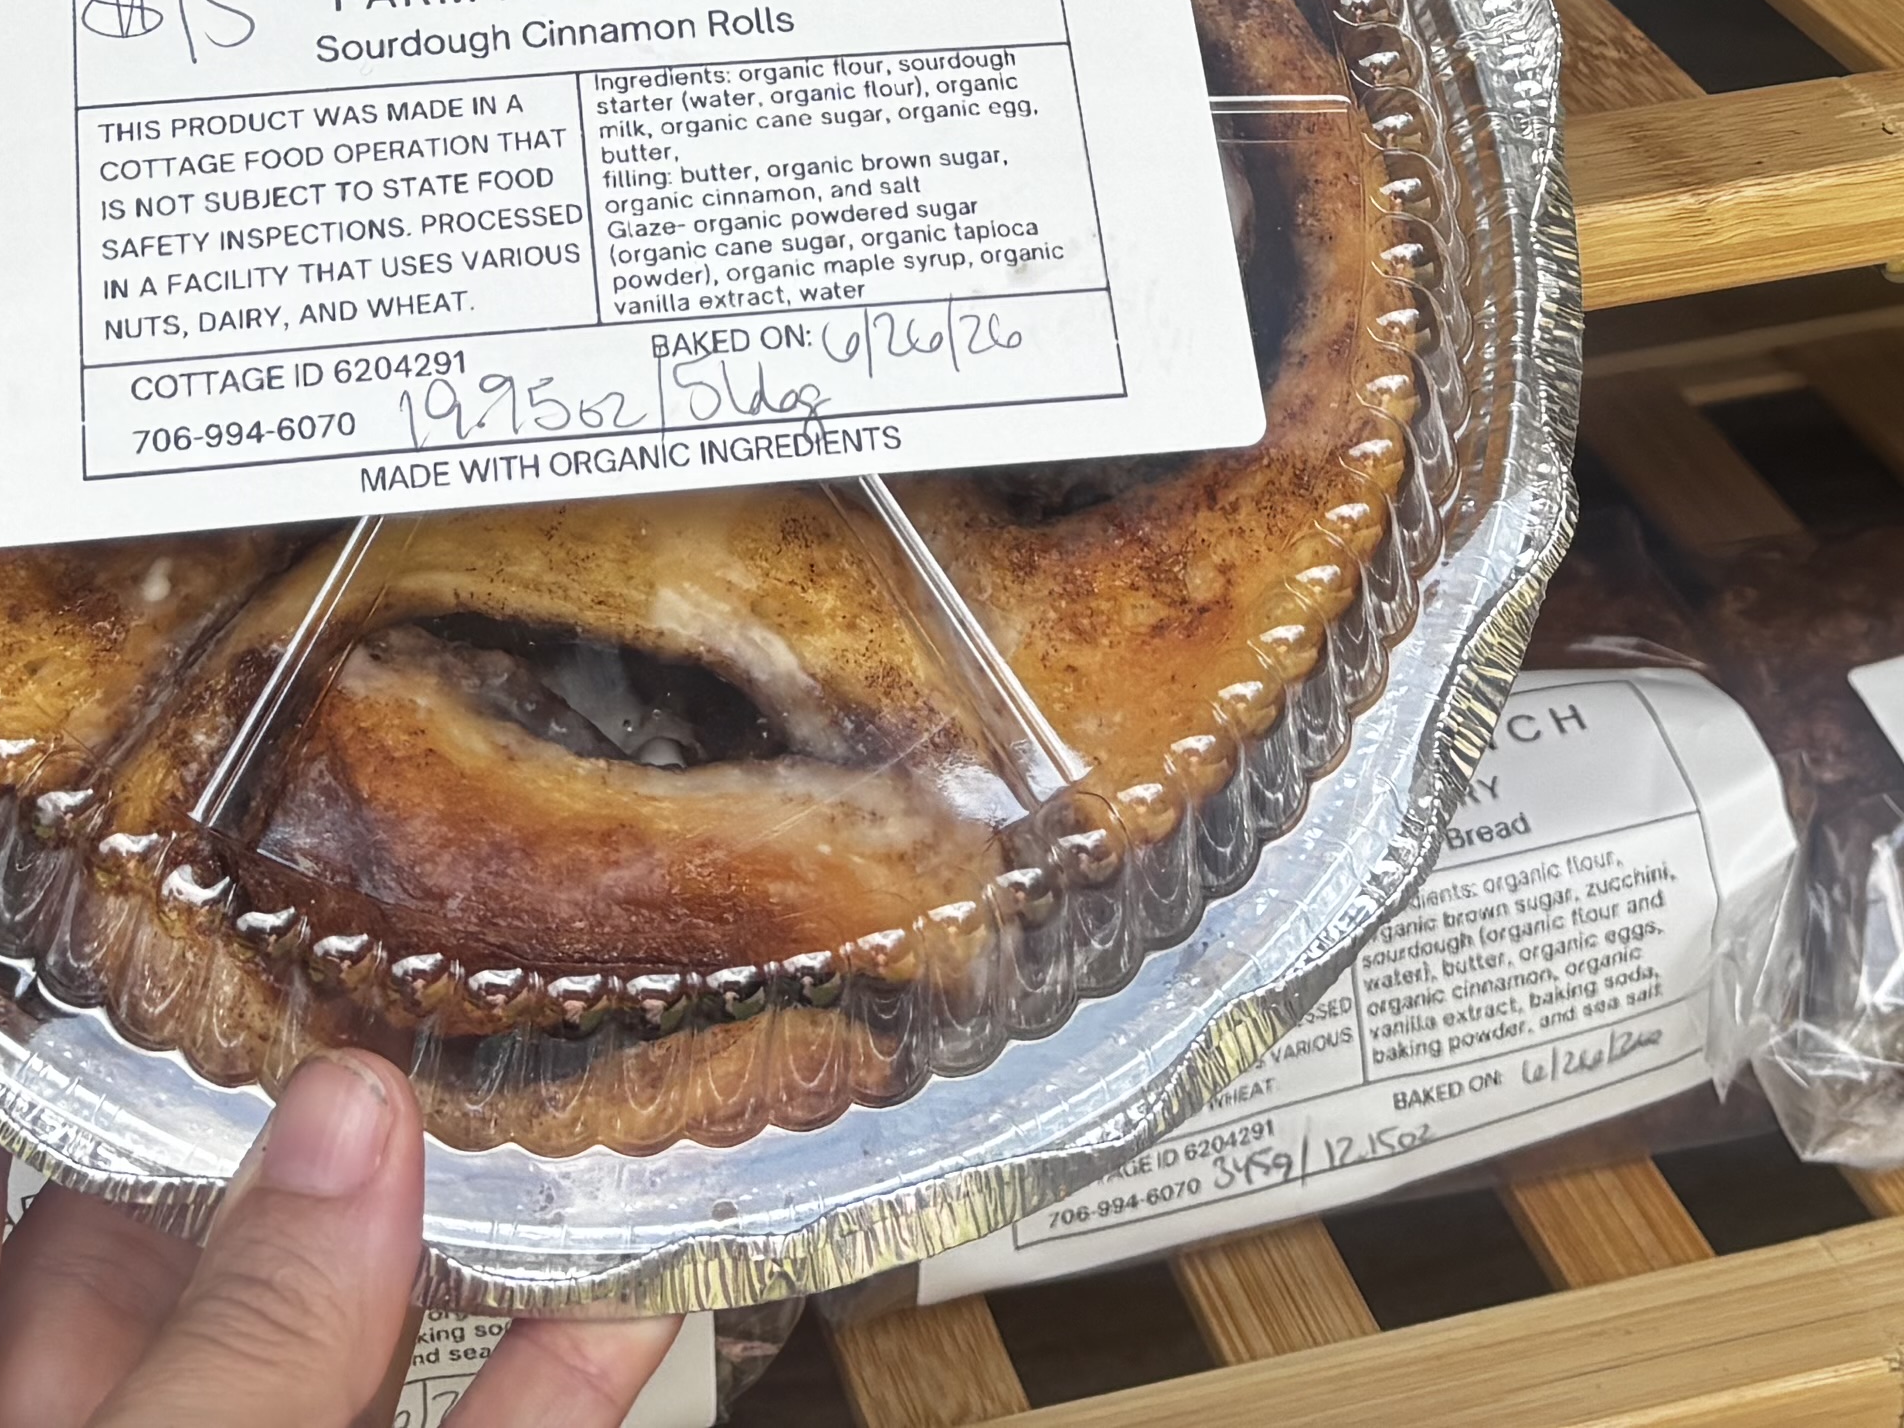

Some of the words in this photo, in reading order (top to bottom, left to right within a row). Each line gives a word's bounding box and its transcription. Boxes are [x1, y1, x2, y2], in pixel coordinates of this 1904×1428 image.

[315, 22, 511, 64] Sourdough
[521, 17, 697, 49] Cinnamon
[707, 5, 796, 38] Rolls
[593, 67, 733, 94] Ingredients:
[738, 61, 826, 87] organic
[831, 56, 894, 78] flour,
[897, 48, 1018, 74] sourdough
[96, 119, 162, 145] THIS
[170, 108, 305, 139] PRODUCT
[312, 103, 379, 128] WAS
[386, 97, 464, 123] MADE
[471, 95, 498, 117] IN
[505, 93, 525, 115] A
[98, 151, 237, 183] COTTAGE
[243, 145, 325, 172] FOOD
[332, 133, 489, 165] OPERATION
[496, 127, 567, 153] THAT
[100, 198, 127, 222] IS
[134, 192, 196, 219] NOT
[203, 182, 328, 214] SUBJECT
[334, 179, 374, 204] TO
[382, 172, 470, 200] STATE
[477, 166, 555, 193] FOOD
[101, 231, 211, 262] SAFETY
[219, 216, 413, 252] INSPECTIONS.
[420, 203, 584, 236] PROCESSED
[102, 277, 129, 301] IN
[138, 275, 158, 298] A
[166, 264, 290, 296] FACILITY
[296, 257, 374, 285] THAT
[380, 251, 454, 279] USES
[460, 241, 581, 272] VARIOUS
[104, 313, 189, 342] NUTS,
[198, 304, 290, 334] DAIRY,
[298, 299, 359, 326] AND
[366, 289, 476, 320] WHEAT.
[650, 327, 751, 363] BAKED
[759, 323, 813, 351] ON:
[129, 364, 286, 402] COTTAGE
[293, 361, 325, 389] ID
[333, 349, 466, 385] 6204291
[131, 410, 357, 456] 706-994-6070
[360, 460, 452, 494] MADE
[458, 453, 541, 485] WITH
[548, 438, 691, 478] ORGANIC
[699, 424, 903, 467] INGREDIENTS
[1446, 811, 1532, 850] Bread
[1482, 862, 1560, 896] organic
[1392, 1081, 1463, 1112] BAKED
[1047, 1178, 1202, 1229] 706-994-6070
